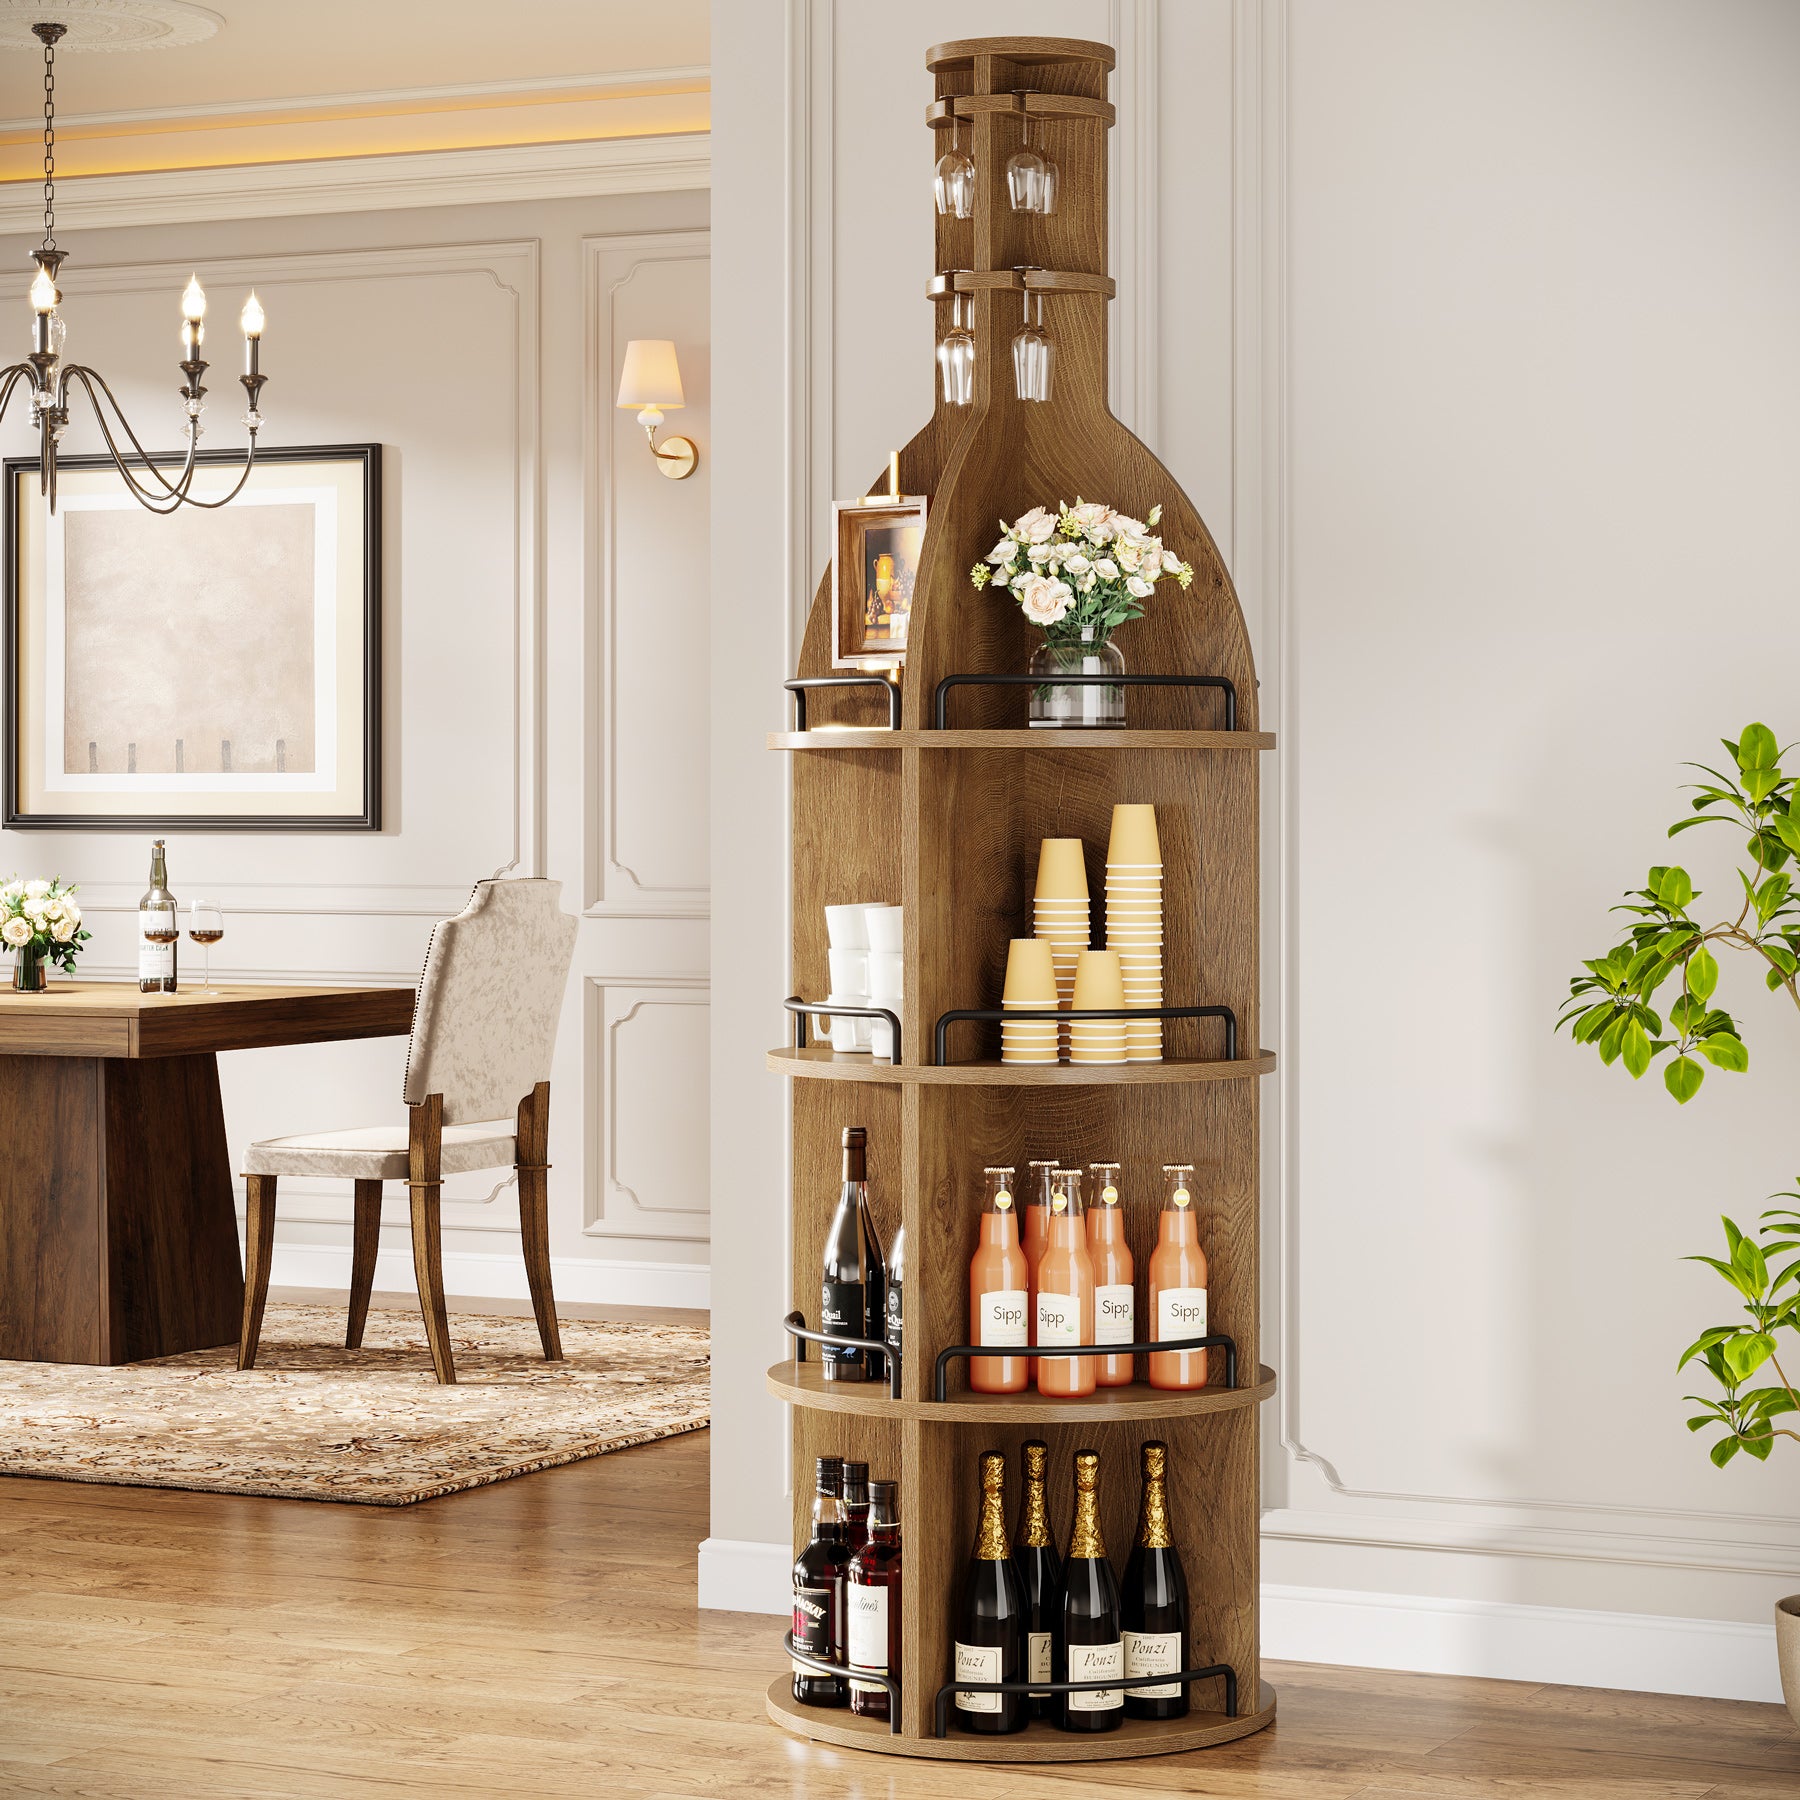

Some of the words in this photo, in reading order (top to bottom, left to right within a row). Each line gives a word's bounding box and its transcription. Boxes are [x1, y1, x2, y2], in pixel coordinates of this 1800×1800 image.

[994, 1306, 1022, 1324] Sipp
[1040, 1308, 1064, 1328] Sipp
[1102, 1300, 1129, 1318] Sipp
[1171, 1303, 1200, 1322] Sipp
[1132, 1640, 1168, 1654] Ponzi
[957, 1651, 987, 1667] Ponzi
[1084, 1651, 1118, 1667] Ponzi
